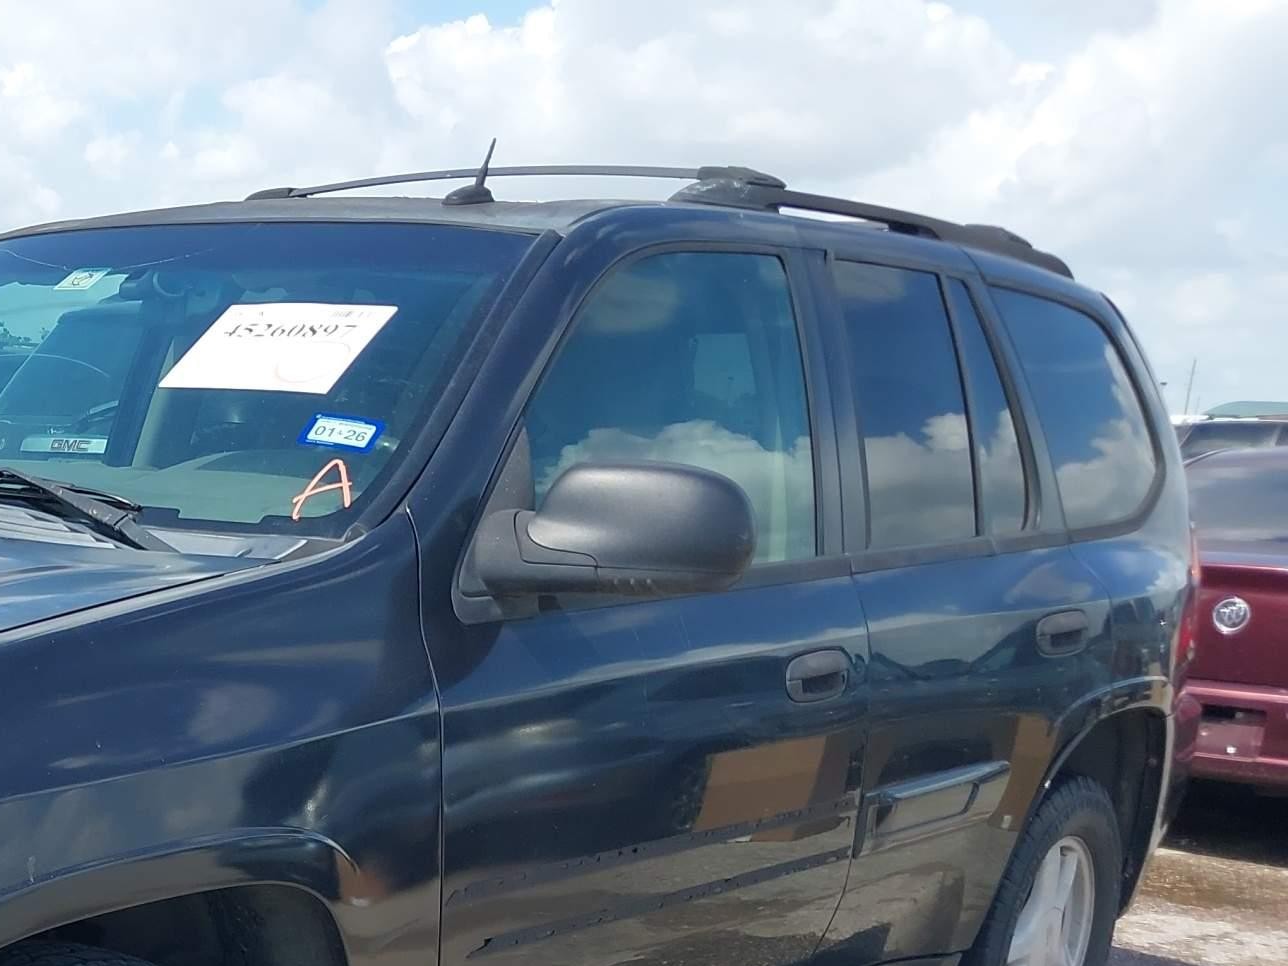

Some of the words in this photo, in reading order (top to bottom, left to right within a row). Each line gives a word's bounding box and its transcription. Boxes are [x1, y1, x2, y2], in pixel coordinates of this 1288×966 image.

[223, 322, 359, 339] 45260897
[314, 425, 336, 438] 01
[343, 429, 367, 443] 26
[50, 439, 90, 450] GMC
[292, 459, 352, 521] A
